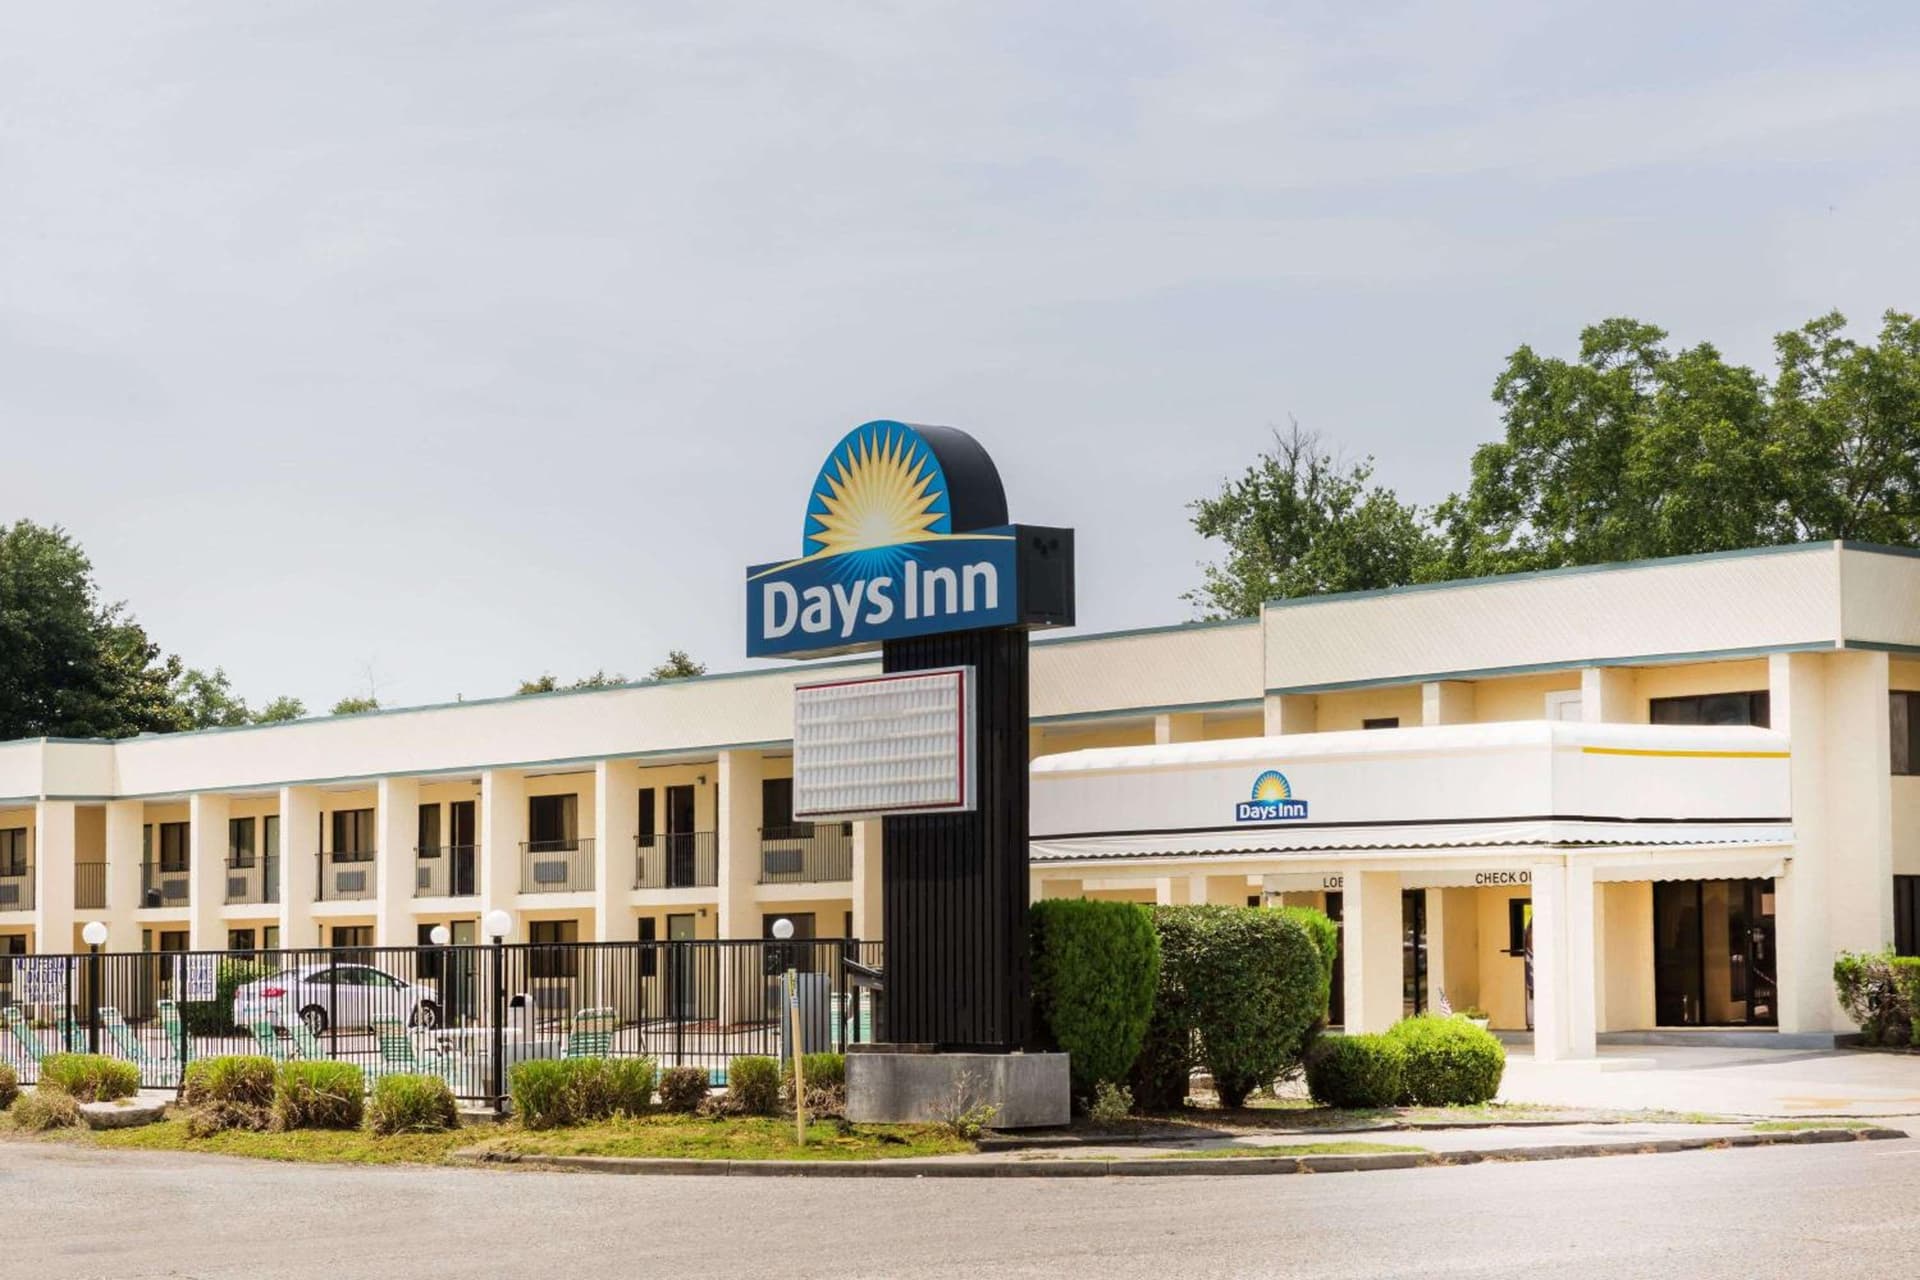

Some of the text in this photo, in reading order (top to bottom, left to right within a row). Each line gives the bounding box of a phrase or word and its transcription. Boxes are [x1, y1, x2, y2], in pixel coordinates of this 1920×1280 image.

[763, 560, 998, 639] Days Inn
[1240, 803, 1304, 820] Days Inn
[1475, 872, 1517, 884] CHECK
